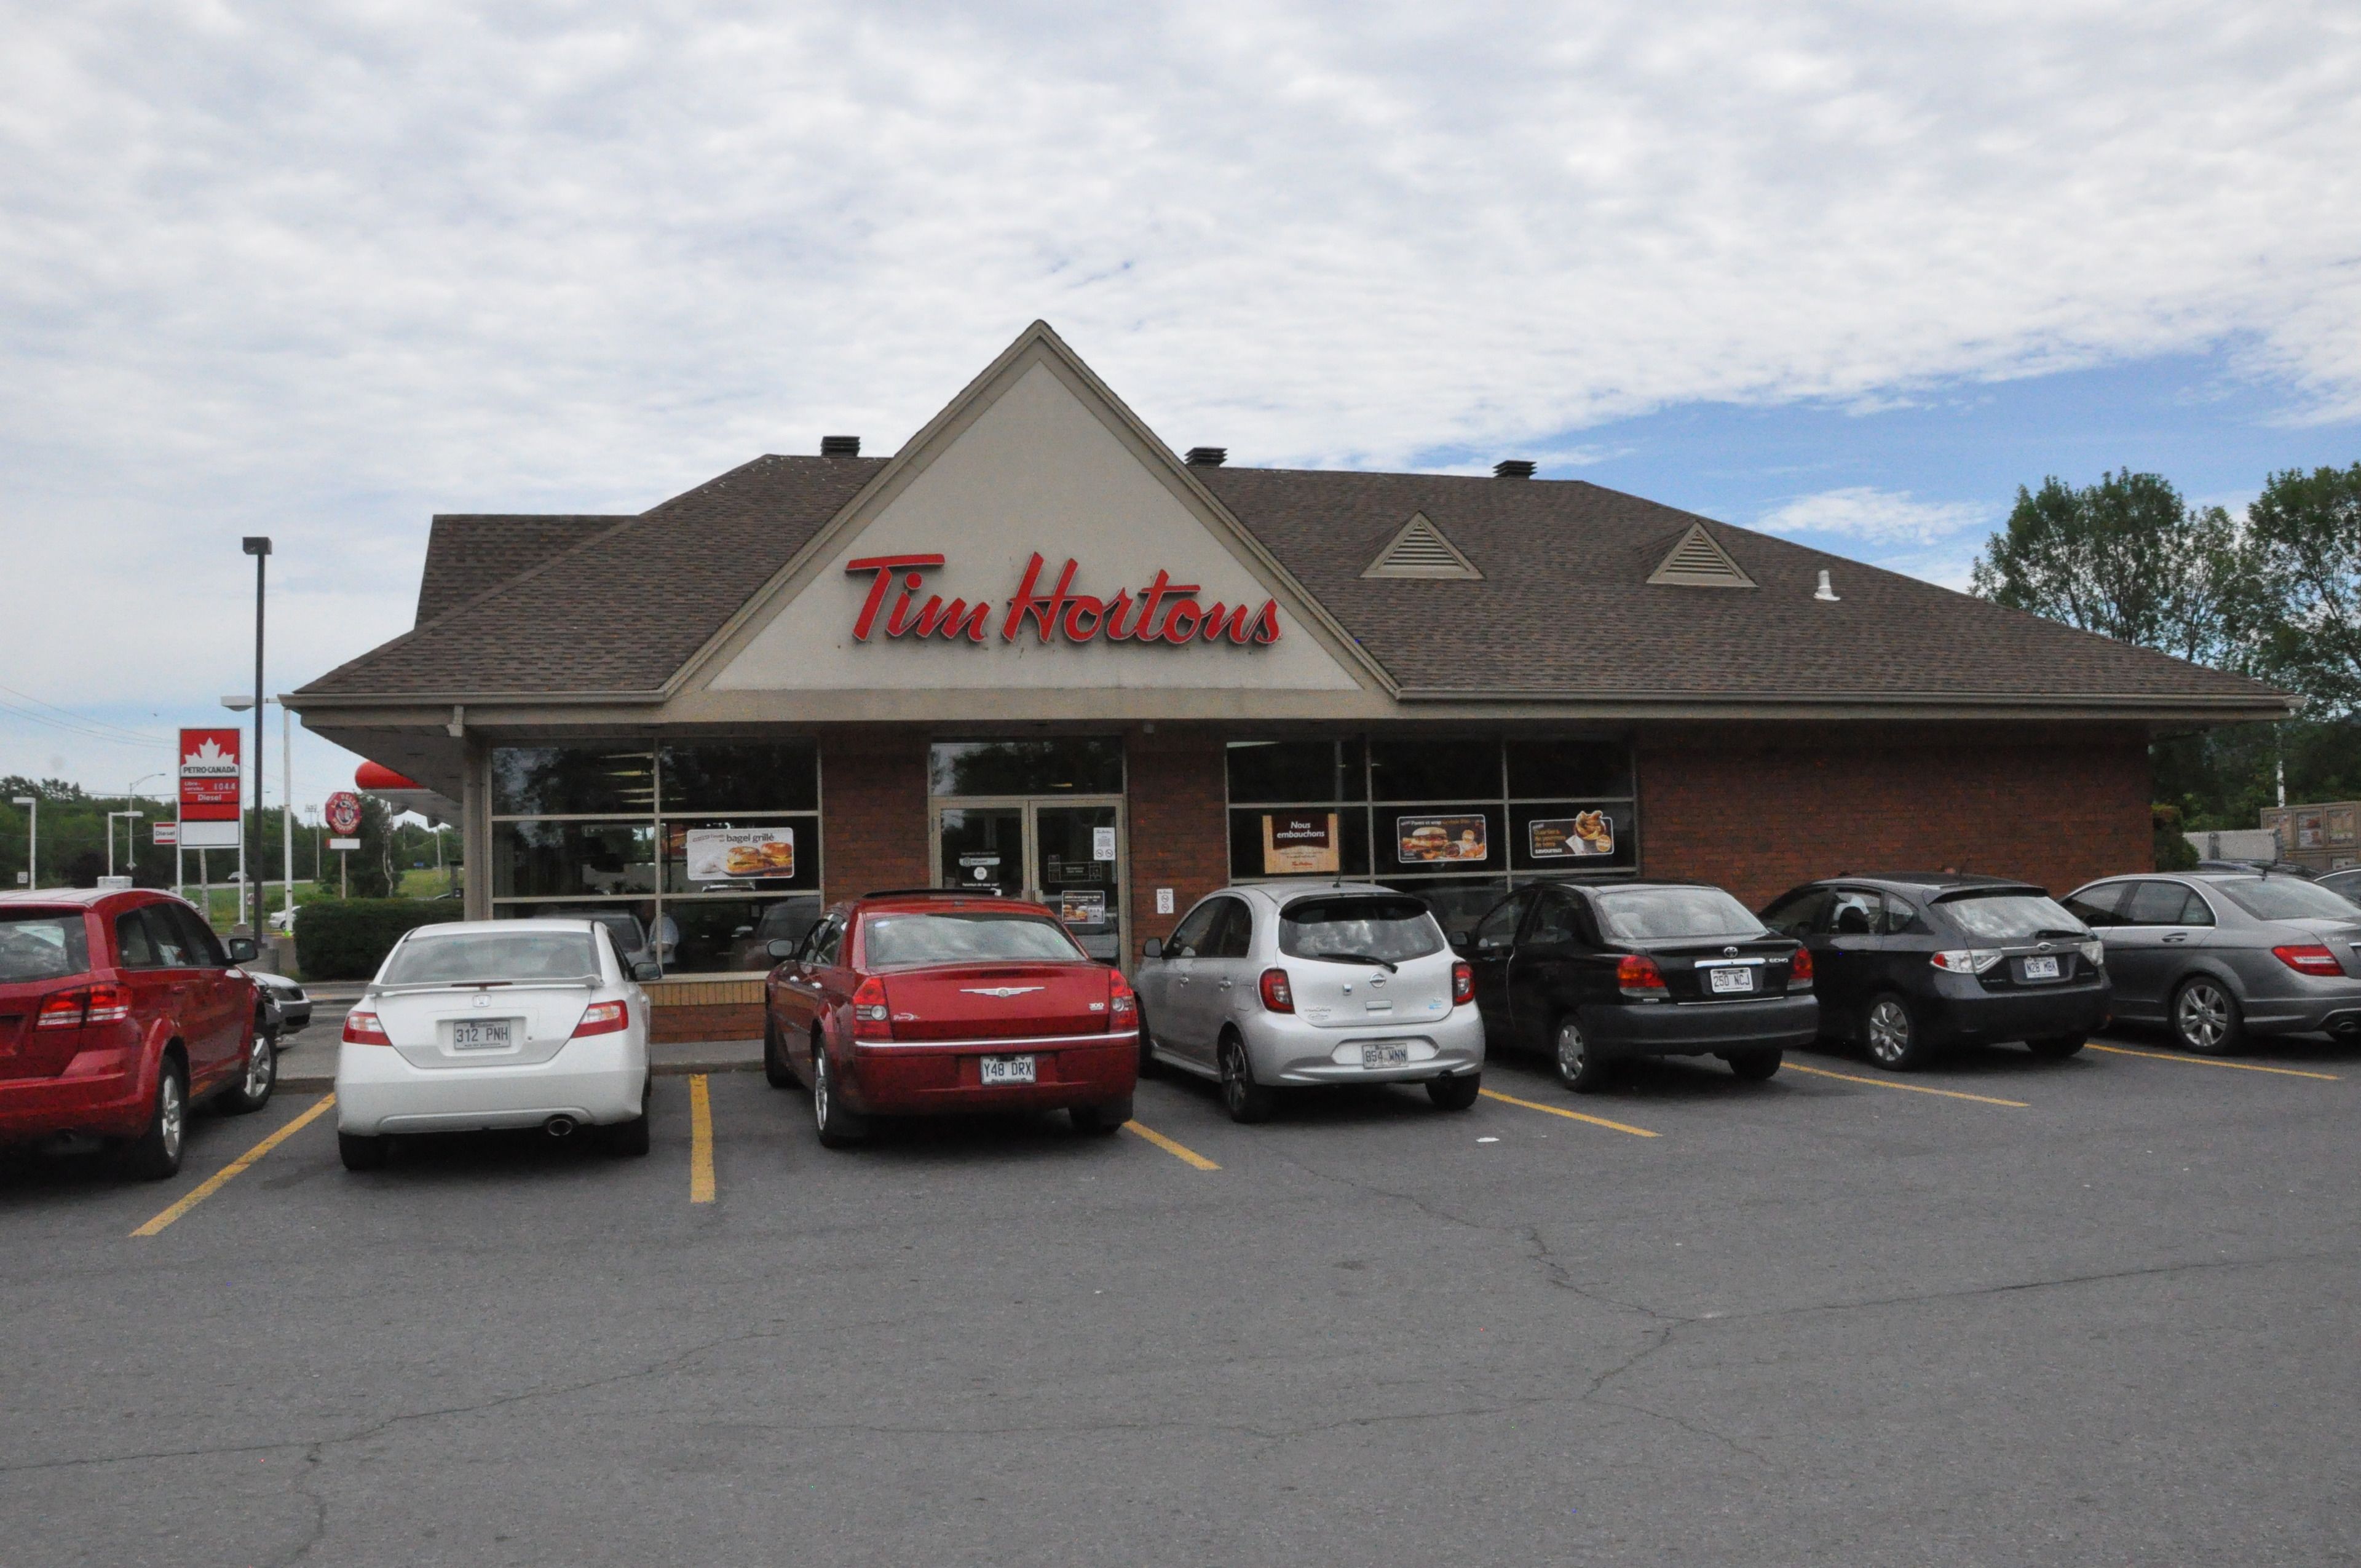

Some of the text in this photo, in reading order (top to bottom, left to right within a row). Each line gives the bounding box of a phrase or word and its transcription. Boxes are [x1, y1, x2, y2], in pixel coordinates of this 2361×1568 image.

[847, 551, 1280, 644] Tim Hortons
[726, 833, 751, 844] bagel
[1276, 830, 1325, 838] embauchons
[1713, 973, 1750, 988] 250 NCJ
[456, 1027, 508, 1042] 312 PNH
[1365, 1049, 1407, 1063] 854 WNN
[983, 1062, 1033, 1077] Y48 DRX
